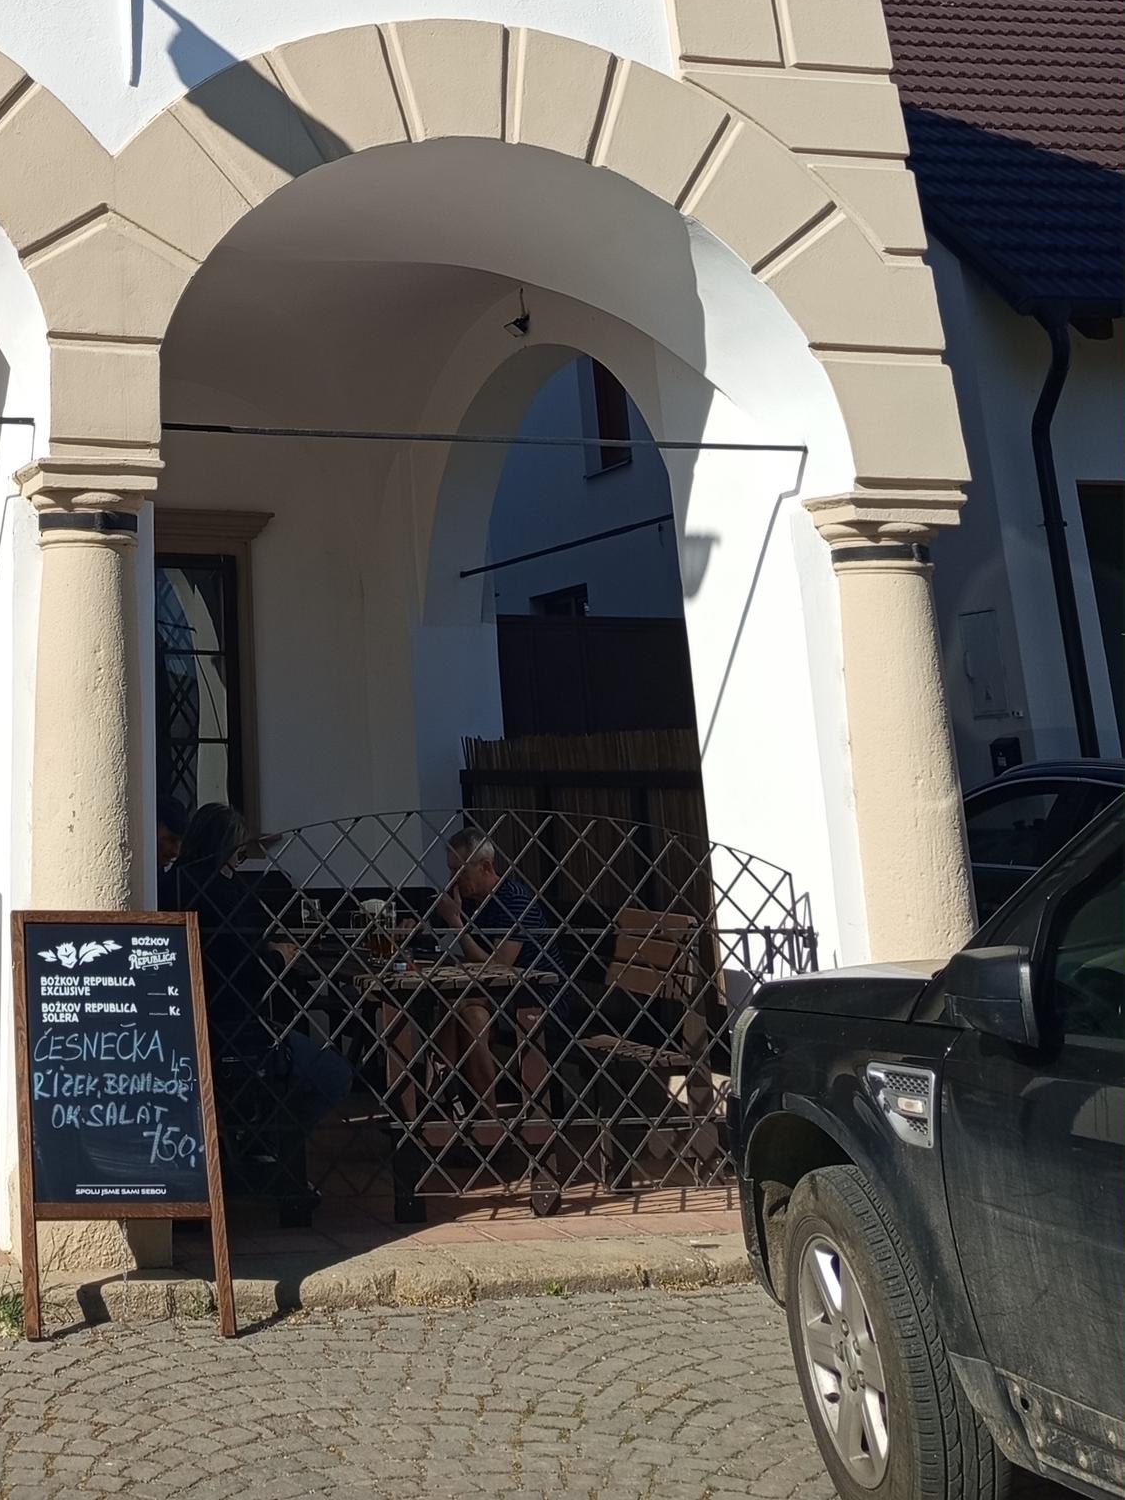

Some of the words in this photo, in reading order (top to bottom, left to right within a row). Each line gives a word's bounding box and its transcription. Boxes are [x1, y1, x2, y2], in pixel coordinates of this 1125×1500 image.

[131, 936, 170, 946] BOŽKOV
[128, 952, 177, 970] REPUBLICA
[40, 975, 80, 987] BOŽKOV
[83, 976, 136, 987] REPUBLICA
[40, 986, 91, 997] EXCLUSIVE
[41, 1002, 81, 1013] BOŽKOV
[85, 1003, 138, 1014] REPUBLICA
[42, 1013, 79, 1023] SOLERA
